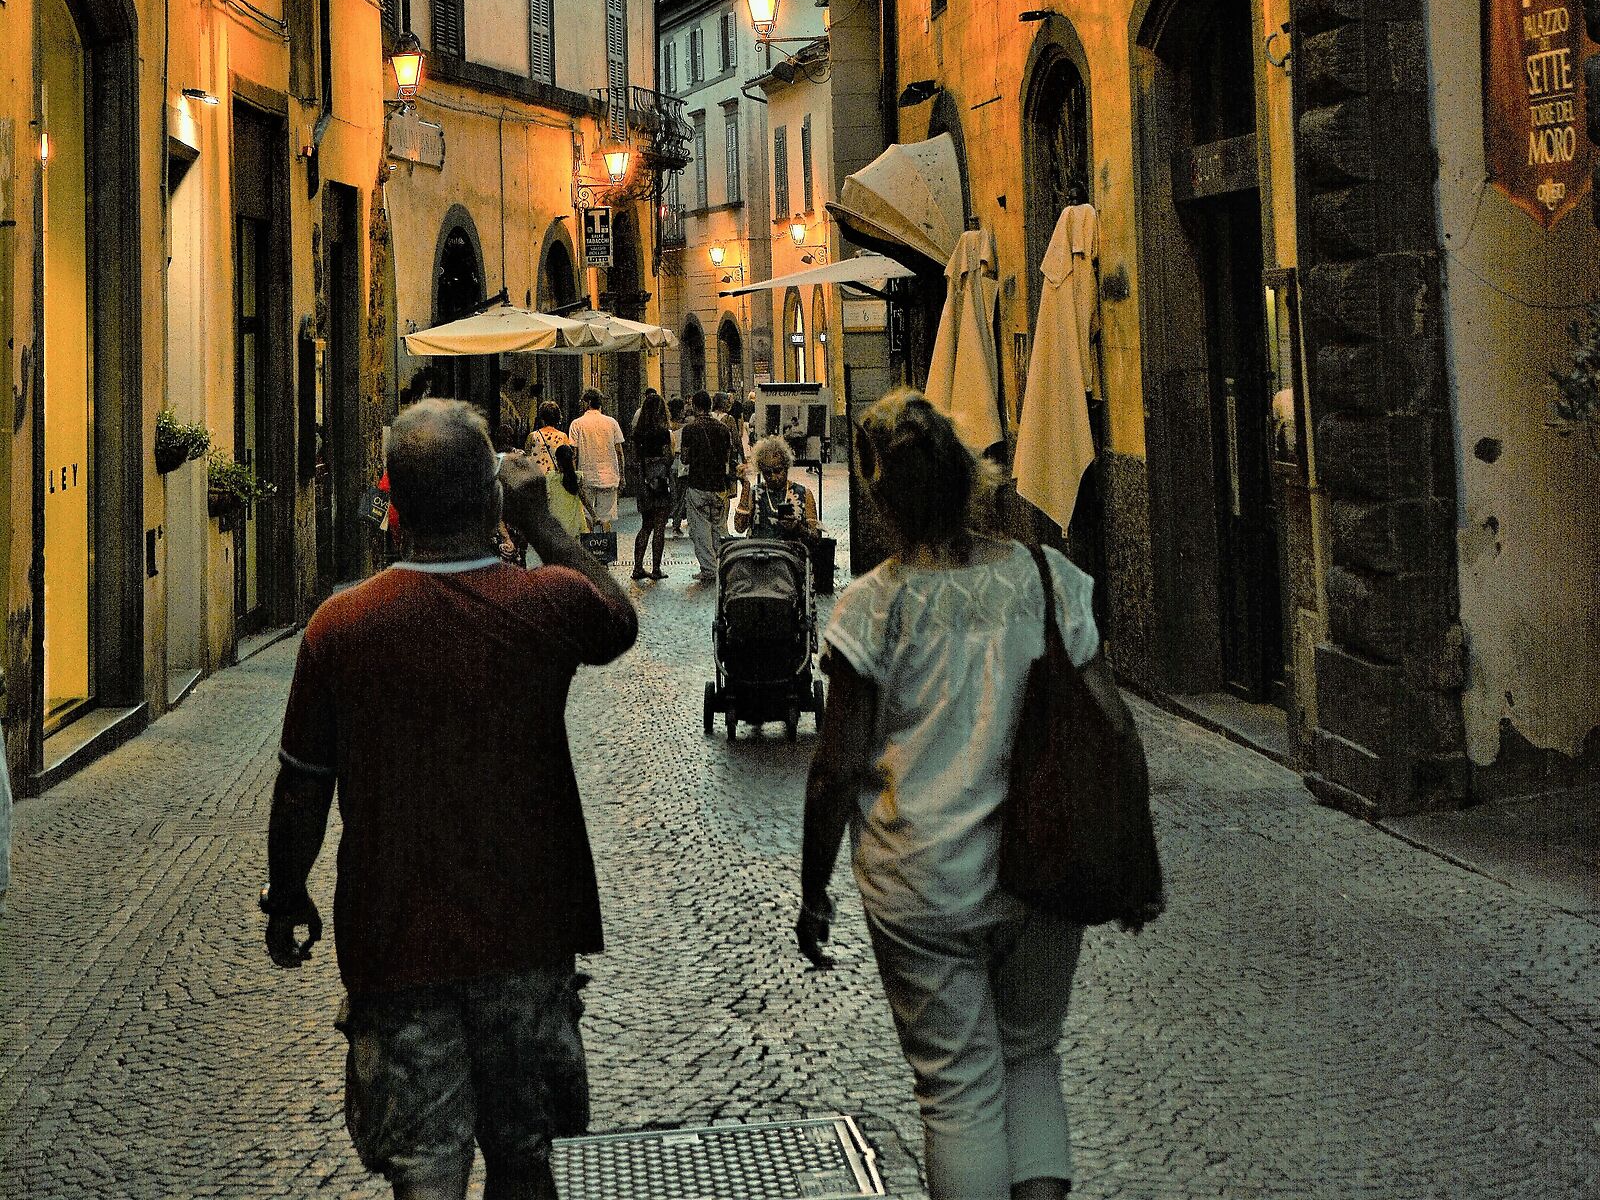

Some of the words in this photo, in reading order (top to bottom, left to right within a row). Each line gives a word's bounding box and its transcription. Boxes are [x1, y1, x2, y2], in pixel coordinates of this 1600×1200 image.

[1523, 8, 1569, 38] PALAZZO
[1527, 48, 1574, 95] SETTE
[1557, 100, 1575, 123] DEL
[1528, 126, 1576, 165] MORO
[588, 210, 606, 234] T
[49, 463, 78, 494] LEY
[590, 539, 608, 547] OVS
